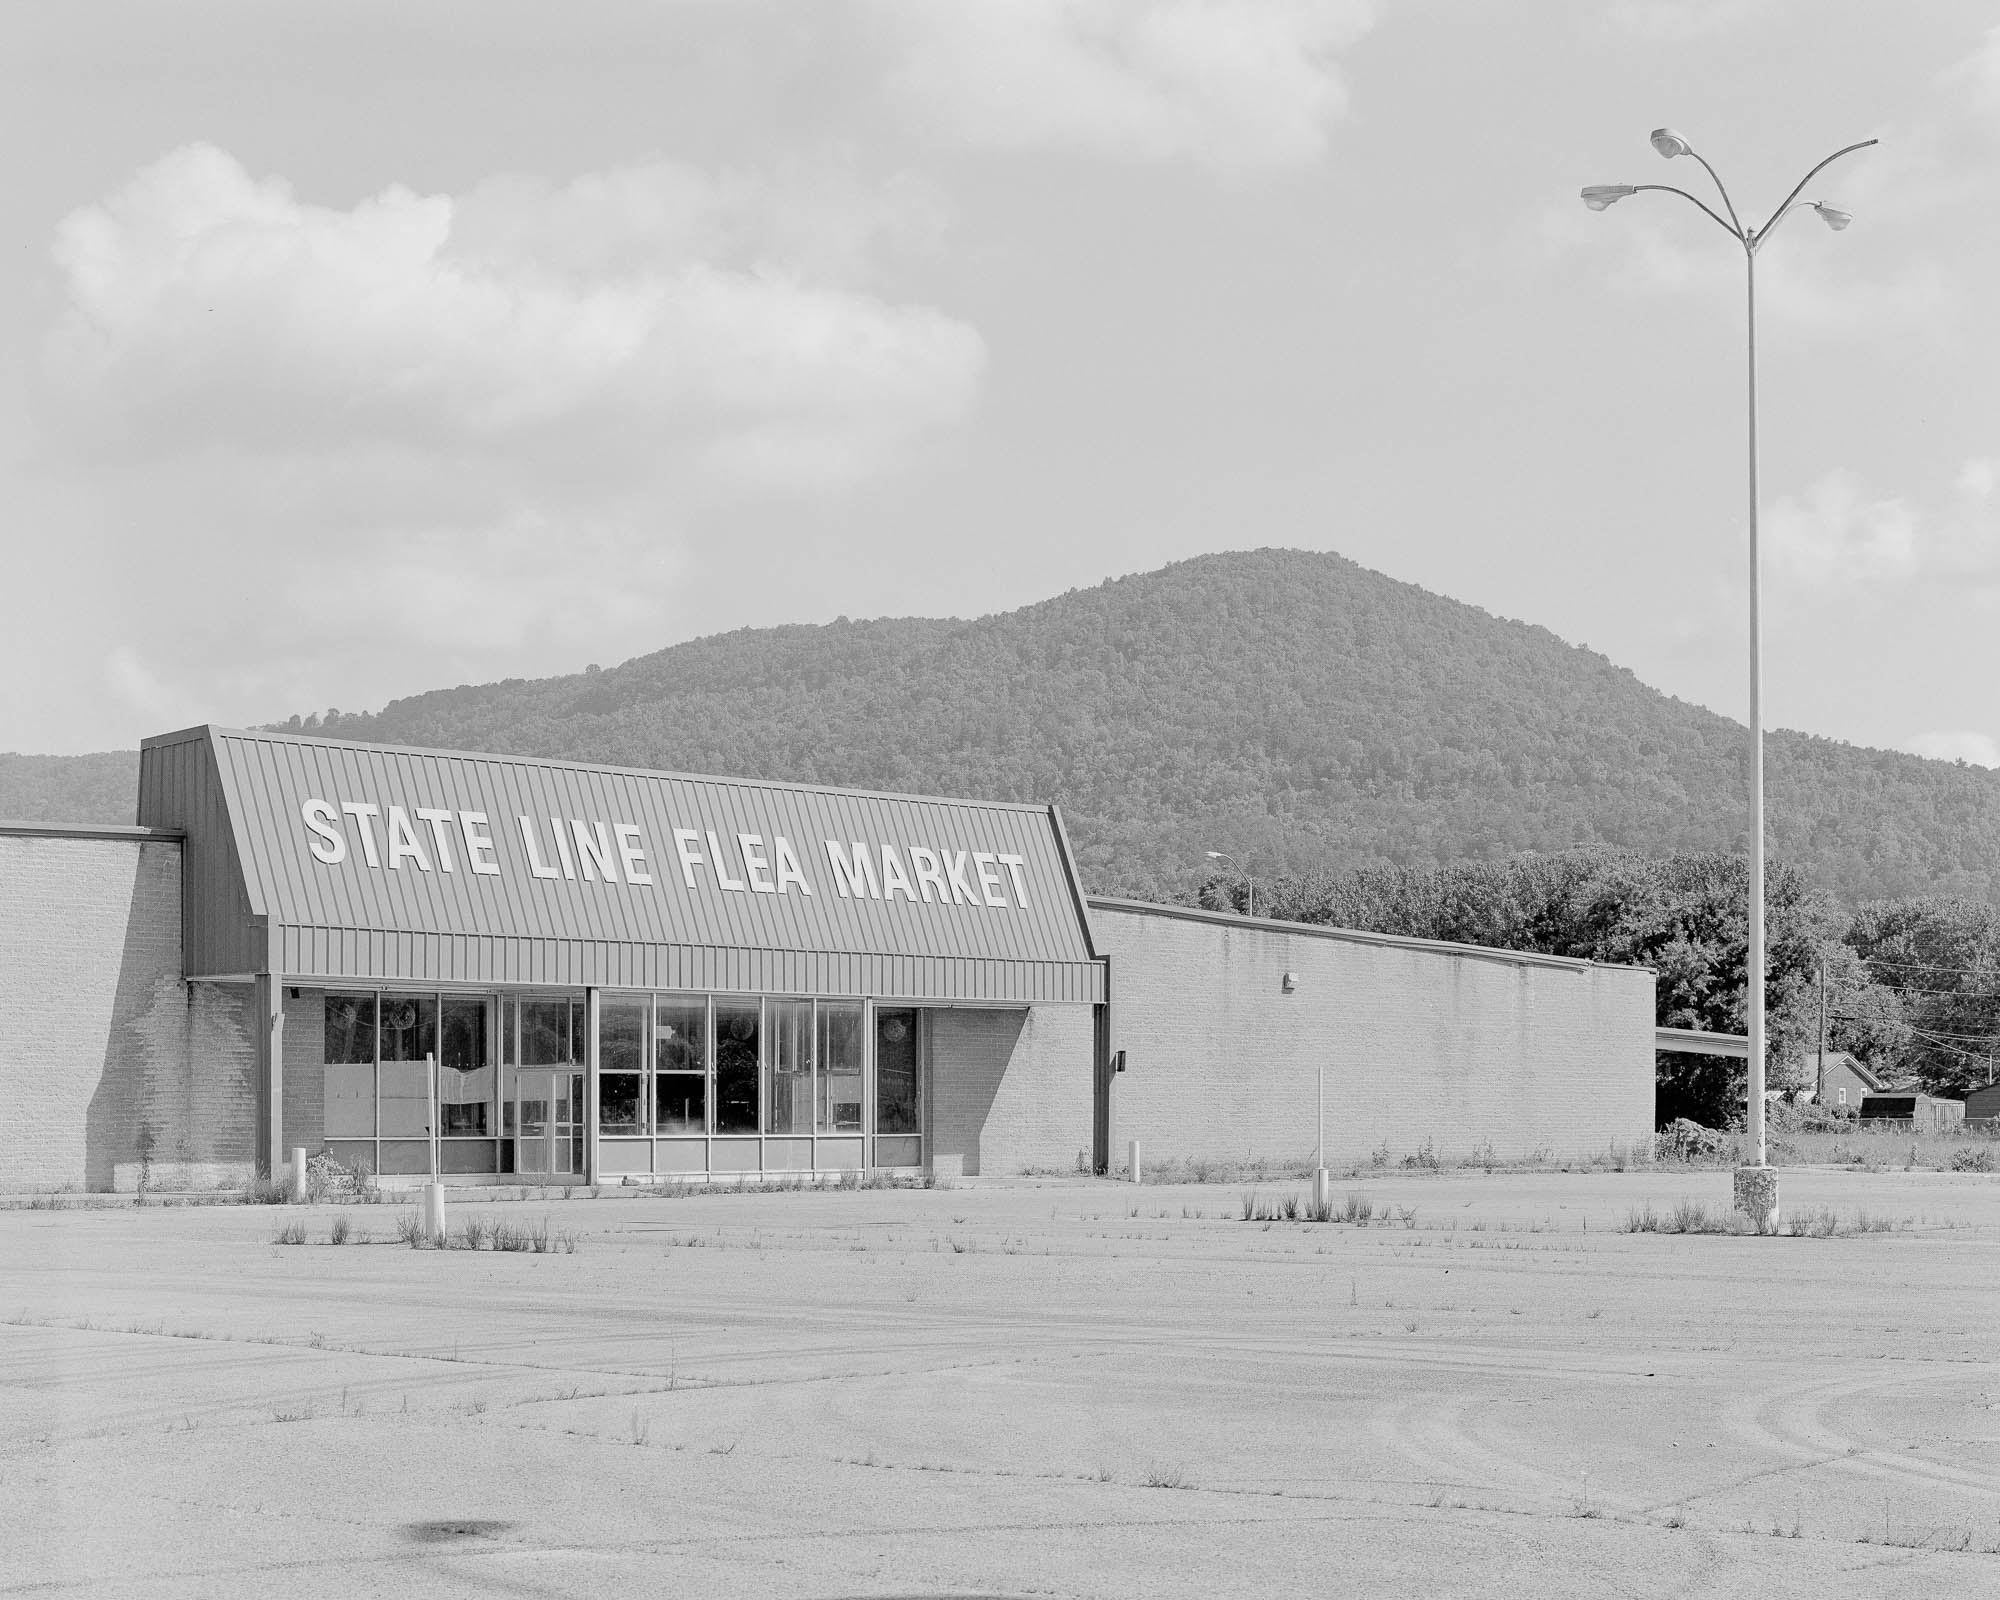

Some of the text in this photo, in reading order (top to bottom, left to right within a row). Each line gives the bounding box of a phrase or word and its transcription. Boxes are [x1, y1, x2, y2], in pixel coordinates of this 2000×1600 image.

[301, 799, 1028, 909] STATE LINE FLEA MARKET
